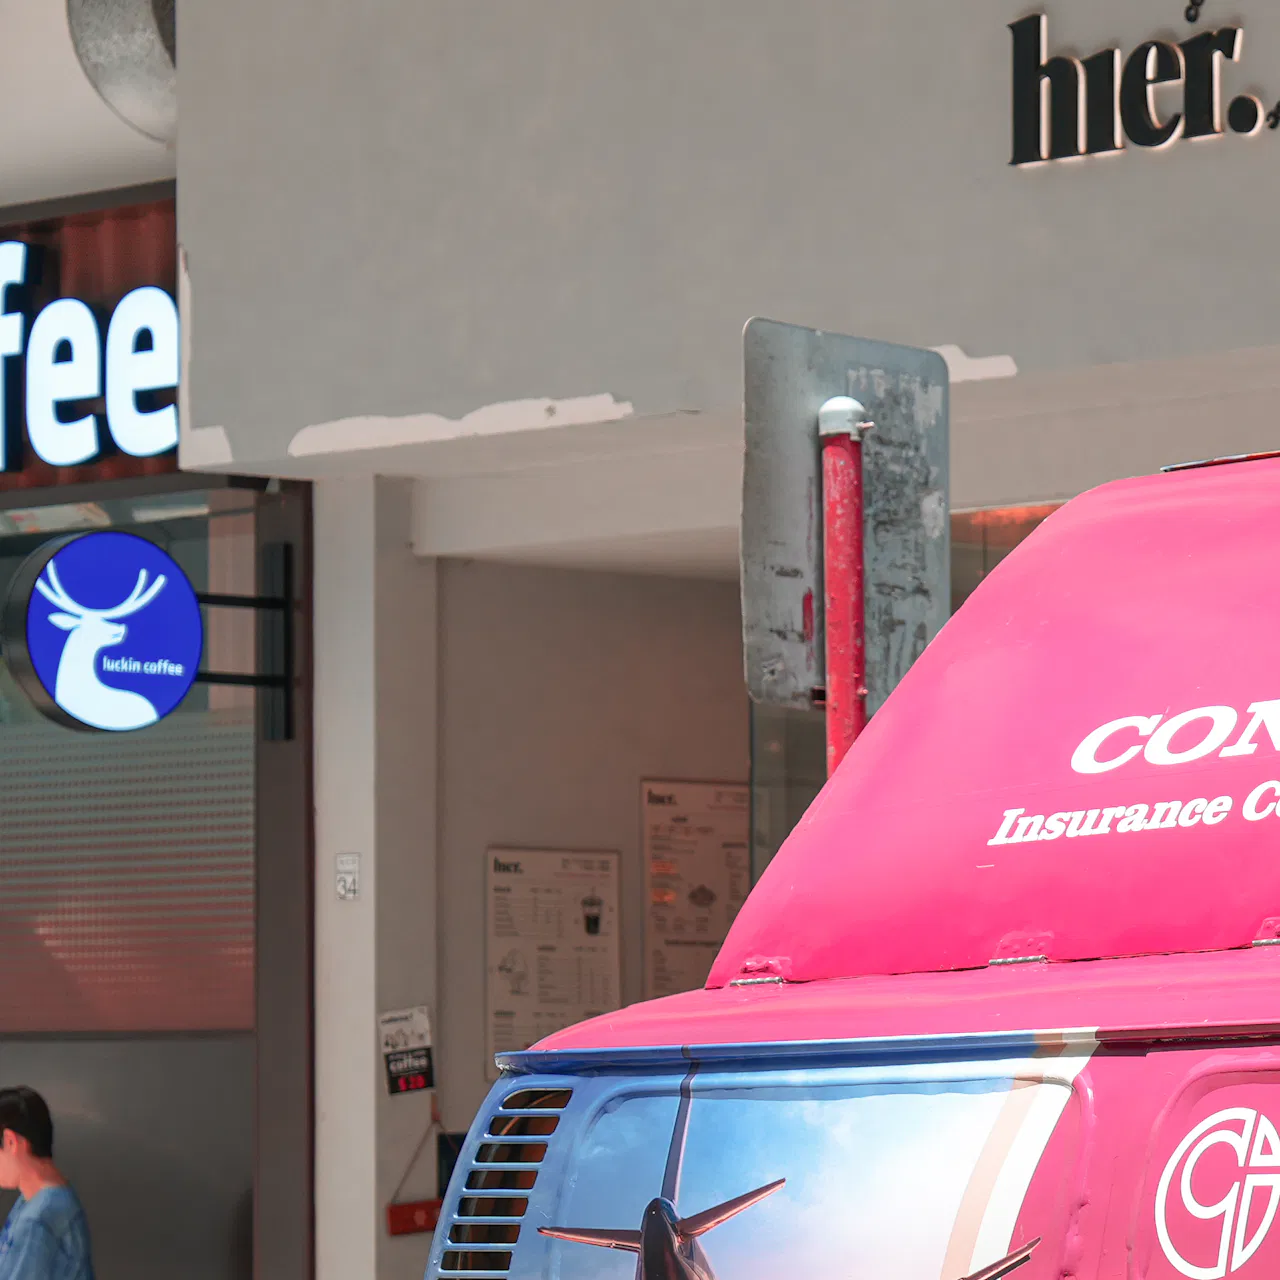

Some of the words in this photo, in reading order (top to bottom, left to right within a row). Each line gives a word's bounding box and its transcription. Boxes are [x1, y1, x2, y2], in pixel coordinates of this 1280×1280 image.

[1008, 14, 1262, 167] hier.
[102, 655, 141, 674] luckin
[143, 658, 185, 677] coffee
[985, 793, 1233, 846] Insurance
